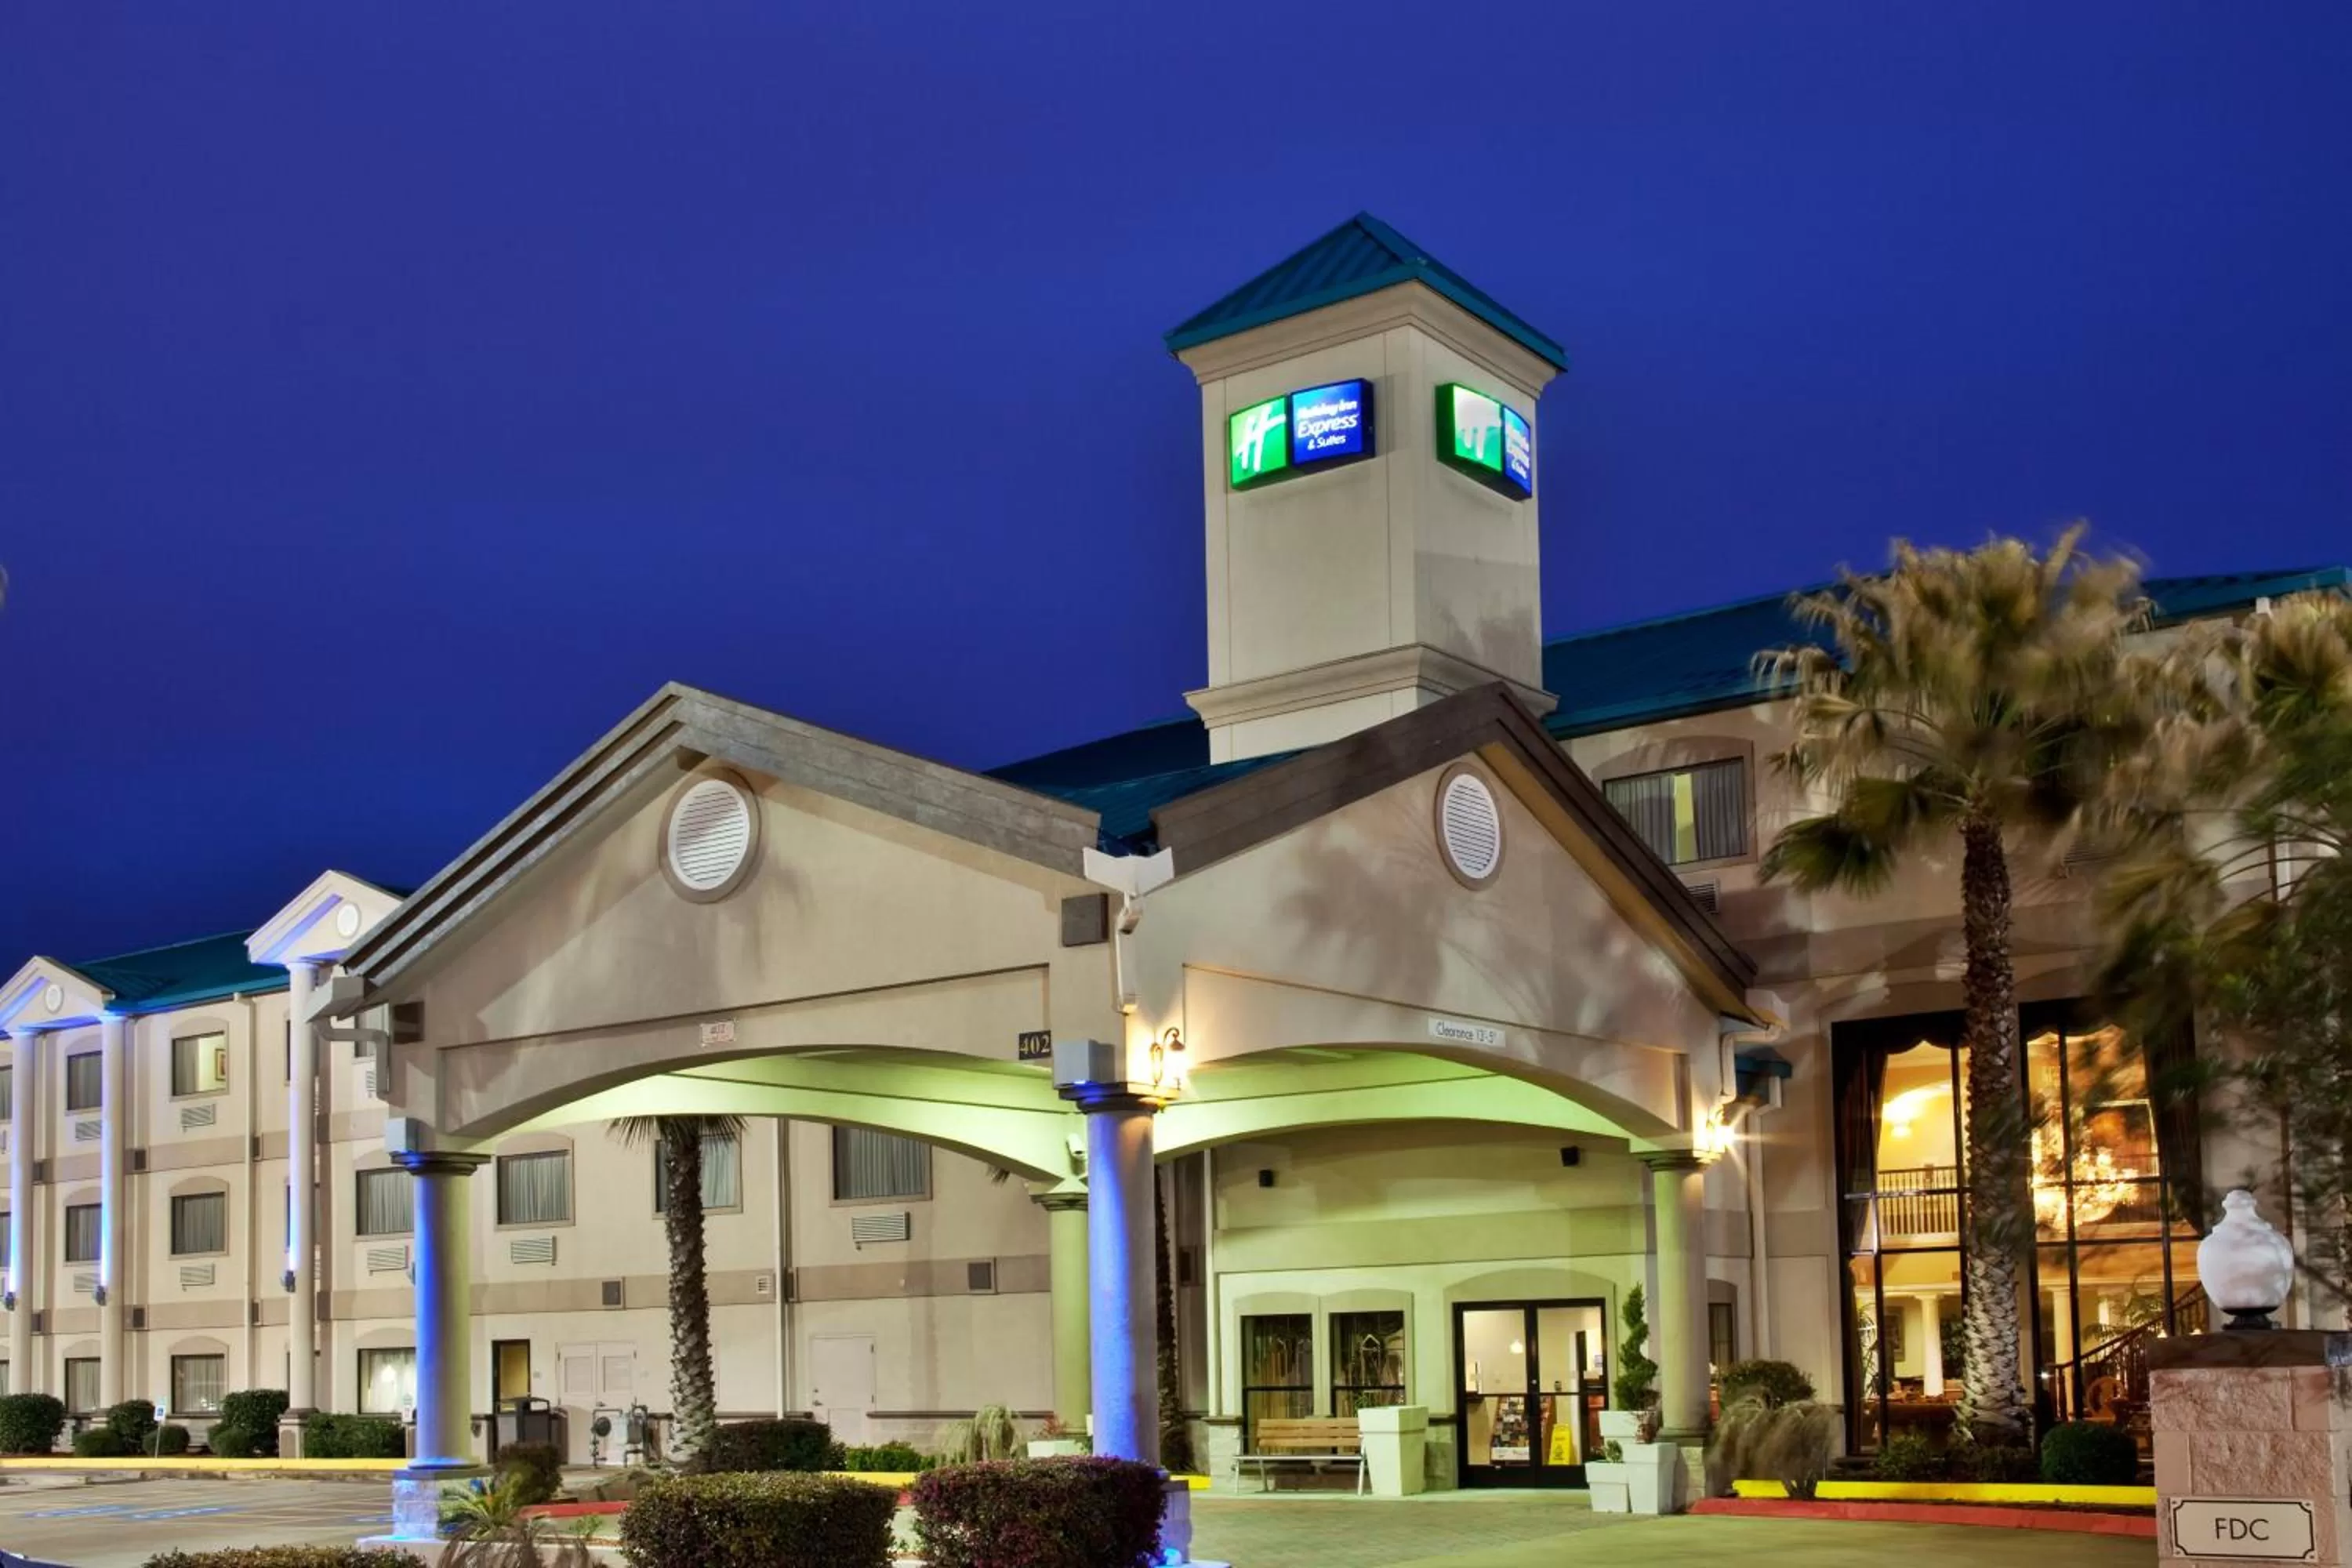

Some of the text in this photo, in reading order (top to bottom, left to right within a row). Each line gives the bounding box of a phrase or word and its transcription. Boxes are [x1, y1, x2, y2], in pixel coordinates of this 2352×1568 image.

[1298, 413, 1360, 438] Express
[1307, 435, 1347, 451] & Suites
[1436, 1022, 1475, 1040] Clearance
[1019, 1035, 1050, 1054] 402
[2215, 1517, 2270, 1541] FDC
